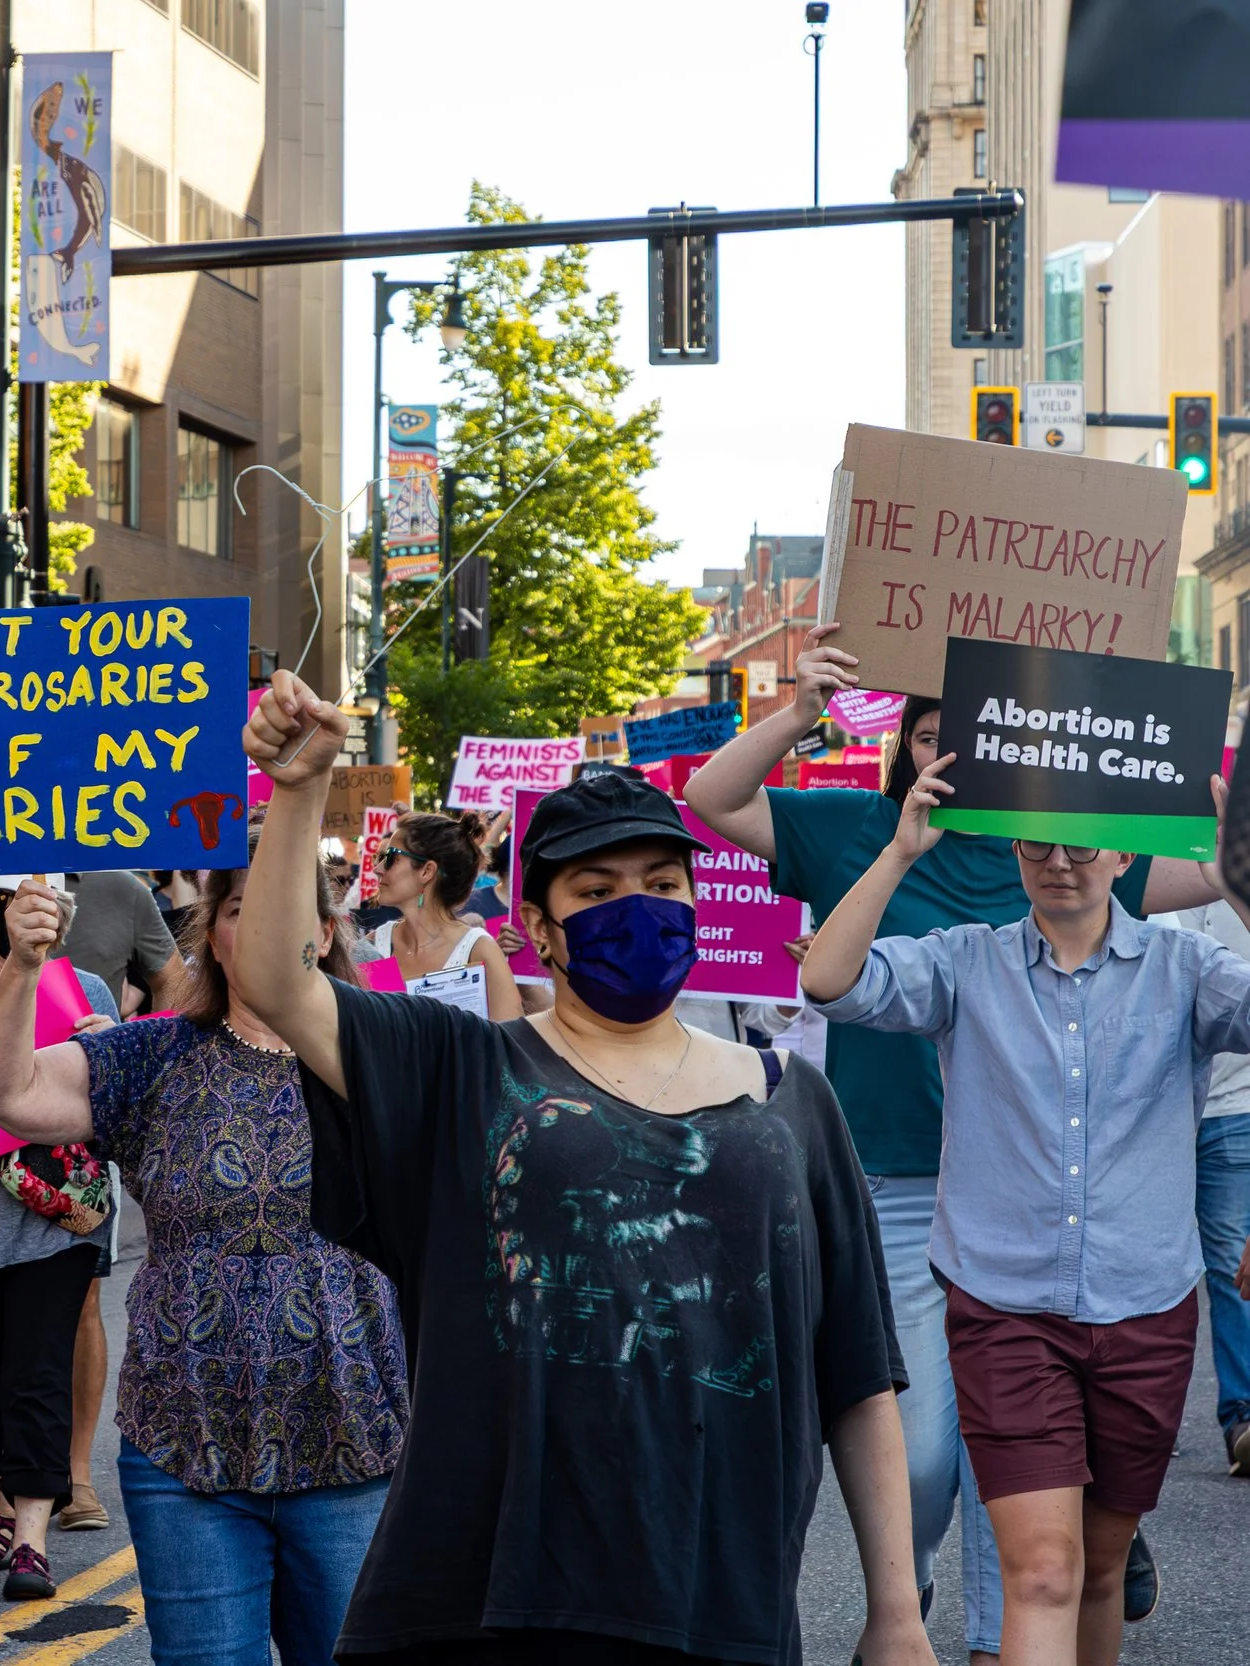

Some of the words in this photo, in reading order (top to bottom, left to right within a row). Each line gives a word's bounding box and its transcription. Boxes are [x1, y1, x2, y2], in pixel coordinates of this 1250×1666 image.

[74, 98, 102, 116] WE
[31, 179, 59, 197] ARE
[37, 198, 63, 218] ALL
[1032, 387, 1053, 398] LEFT
[1056, 387, 1077, 398] TURN
[1039, 399, 1071, 412] YIELD
[1029, 415, 1041, 424] ON
[1044, 415, 1082, 425] FLASHING
[852, 499, 916, 553] THE
[933, 509, 1166, 589] PATRIARCHY
[876, 581, 926, 631] IS
[947, 592, 1123, 656] MALARKY!
[60, 607, 193, 657] YOUR
[848, 697, 907, 724] PARENTHO
[977, 697, 1135, 741] Abortion
[1143, 714, 1171, 747] is
[95, 726, 199, 773] MY
[464, 741, 580, 761] FEMINISTS
[974, 734, 1088, 773] Health
[1098, 751, 1185, 784] Care.
[475, 763, 566, 782] AGAINST
[808, 777, 848, 786] Abortion
[361, 791, 375, 806] IS
[454, 785, 492, 803] THE
[325, 811, 365, 828] HEALT
[691, 850, 769, 872] GAINS
[697, 882, 780, 905] RTION!
[696, 926, 734, 940] GHT
[697, 948, 763, 965] RIGHTS!
